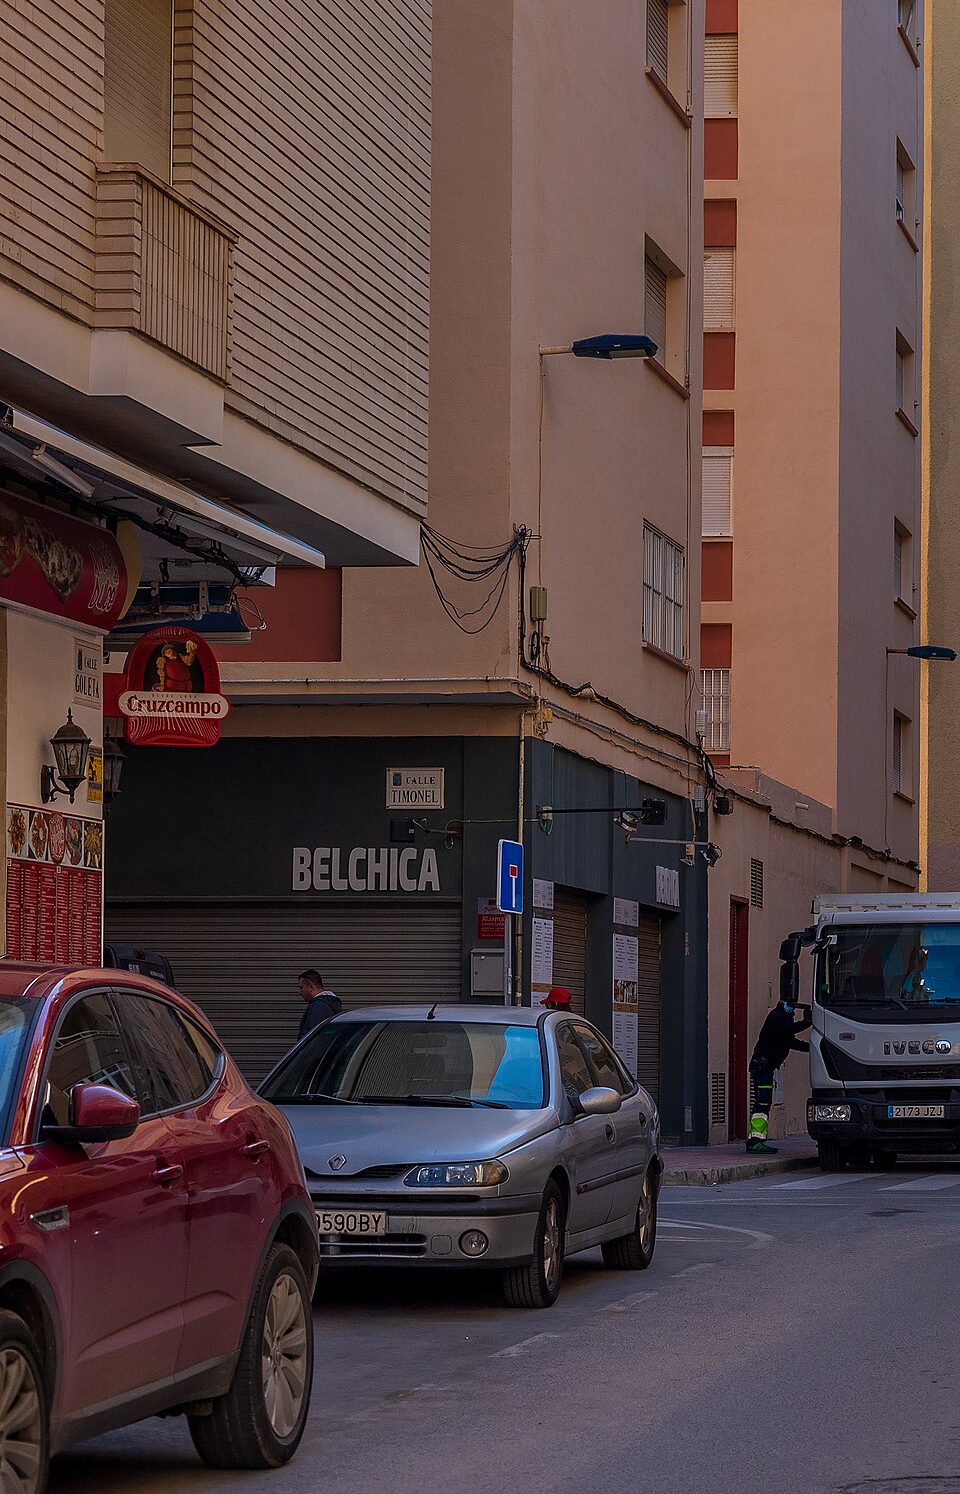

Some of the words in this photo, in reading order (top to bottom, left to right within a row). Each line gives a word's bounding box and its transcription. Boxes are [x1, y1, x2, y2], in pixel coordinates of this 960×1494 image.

[84, 657, 98, 670] CALLE
[75, 674, 100, 698] GOLETA
[127, 695, 221, 717] Cruzcampo
[406, 776, 436, 785] CALLE
[391, 790, 438, 803] TIMONEL
[292, 847, 440, 892] BELCHICA
[883, 1039, 952, 1055] IVECO
[894, 1107, 921, 1117] 2173
[923, 1107, 943, 1117] JZJ
